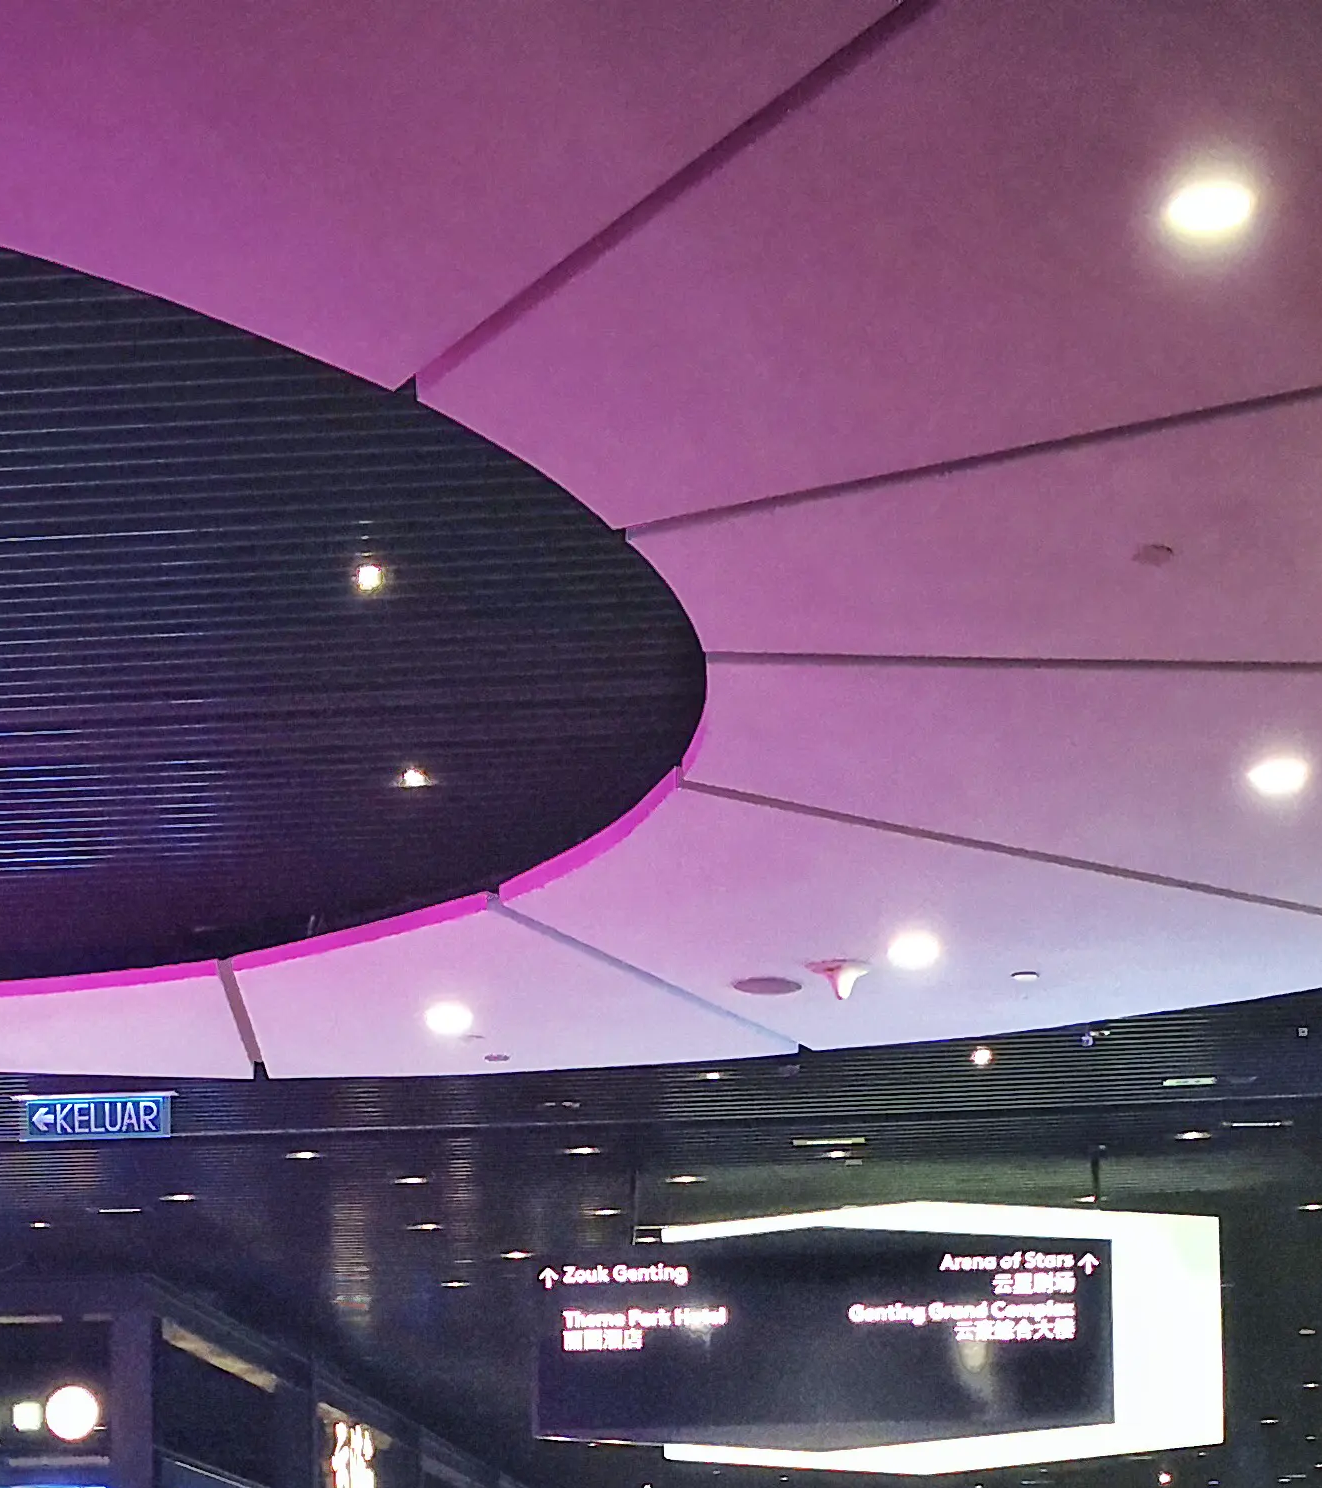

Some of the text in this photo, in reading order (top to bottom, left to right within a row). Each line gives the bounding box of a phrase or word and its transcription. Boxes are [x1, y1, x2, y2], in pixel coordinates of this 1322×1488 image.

[55, 1102, 158, 1134] KELUAR
[939, 1251, 1075, 1271] Arena of Stars
[562, 1263, 690, 1287] Zouk Genting
[562, 1306, 727, 1329] Theme Park Hotel
[848, 1300, 1076, 1326] Genting Grand Complex
